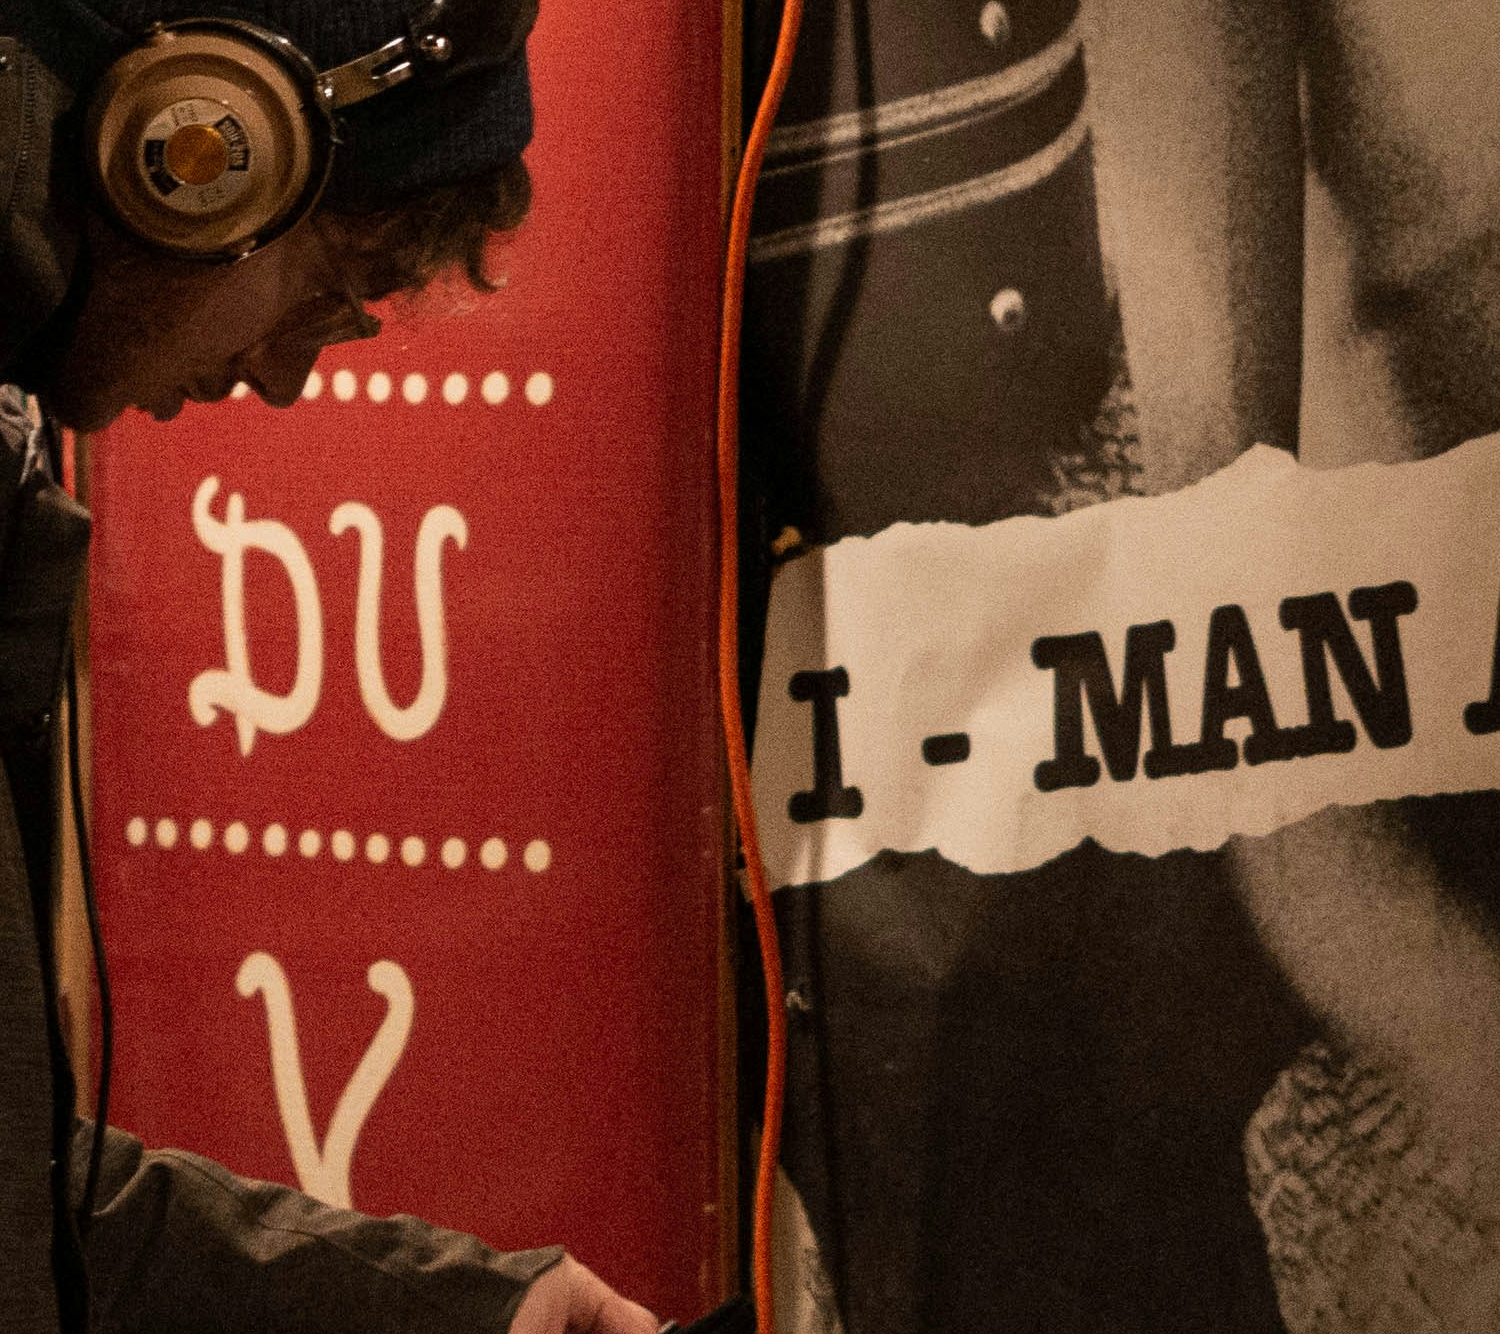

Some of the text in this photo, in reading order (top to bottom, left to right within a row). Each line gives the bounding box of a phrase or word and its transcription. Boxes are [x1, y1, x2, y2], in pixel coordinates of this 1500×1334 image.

[186, 473, 470, 757] DU
[786, 667, 864, 825] I
[1032, 579, 1418, 792] MAN
